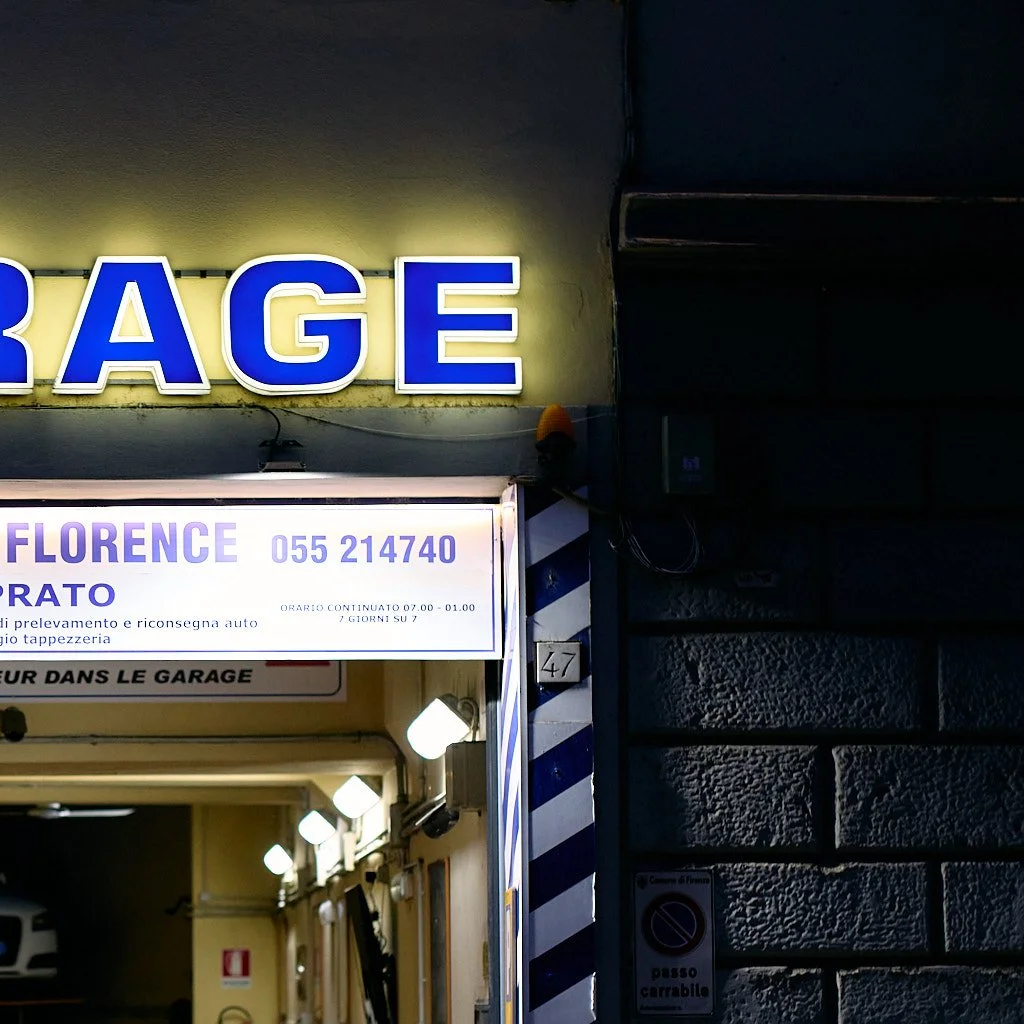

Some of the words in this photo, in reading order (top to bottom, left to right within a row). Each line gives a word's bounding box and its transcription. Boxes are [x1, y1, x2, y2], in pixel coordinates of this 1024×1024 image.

[6, 521, 237, 564] FLORENCE
[271, 535, 329, 564] 055
[340, 535, 456, 564] 214740
[280, 604, 323, 612] ORARIO
[327, 604, 400, 612] CONTINUATO
[403, 604, 434, 612] 07.00
[445, 604, 476, 612] 01.00
[15, 617, 118, 632] prelevamento
[123, 619, 132, 629] e
[137, 617, 219, 632] riconsegna
[224, 618, 258, 629] auto
[348, 615, 389, 623] GIORNI
[393, 615, 407, 623] SU
[411, 615, 418, 623] 7
[23, 633, 111, 648] tappezzeria
[541, 652, 576, 677] 47
[44, 669, 110, 685] DANS
[116, 669, 147, 685] LE
[154, 669, 253, 685] GARAGE
[651, 967, 698, 980] passo
[640, 983, 709, 997] carrabile
